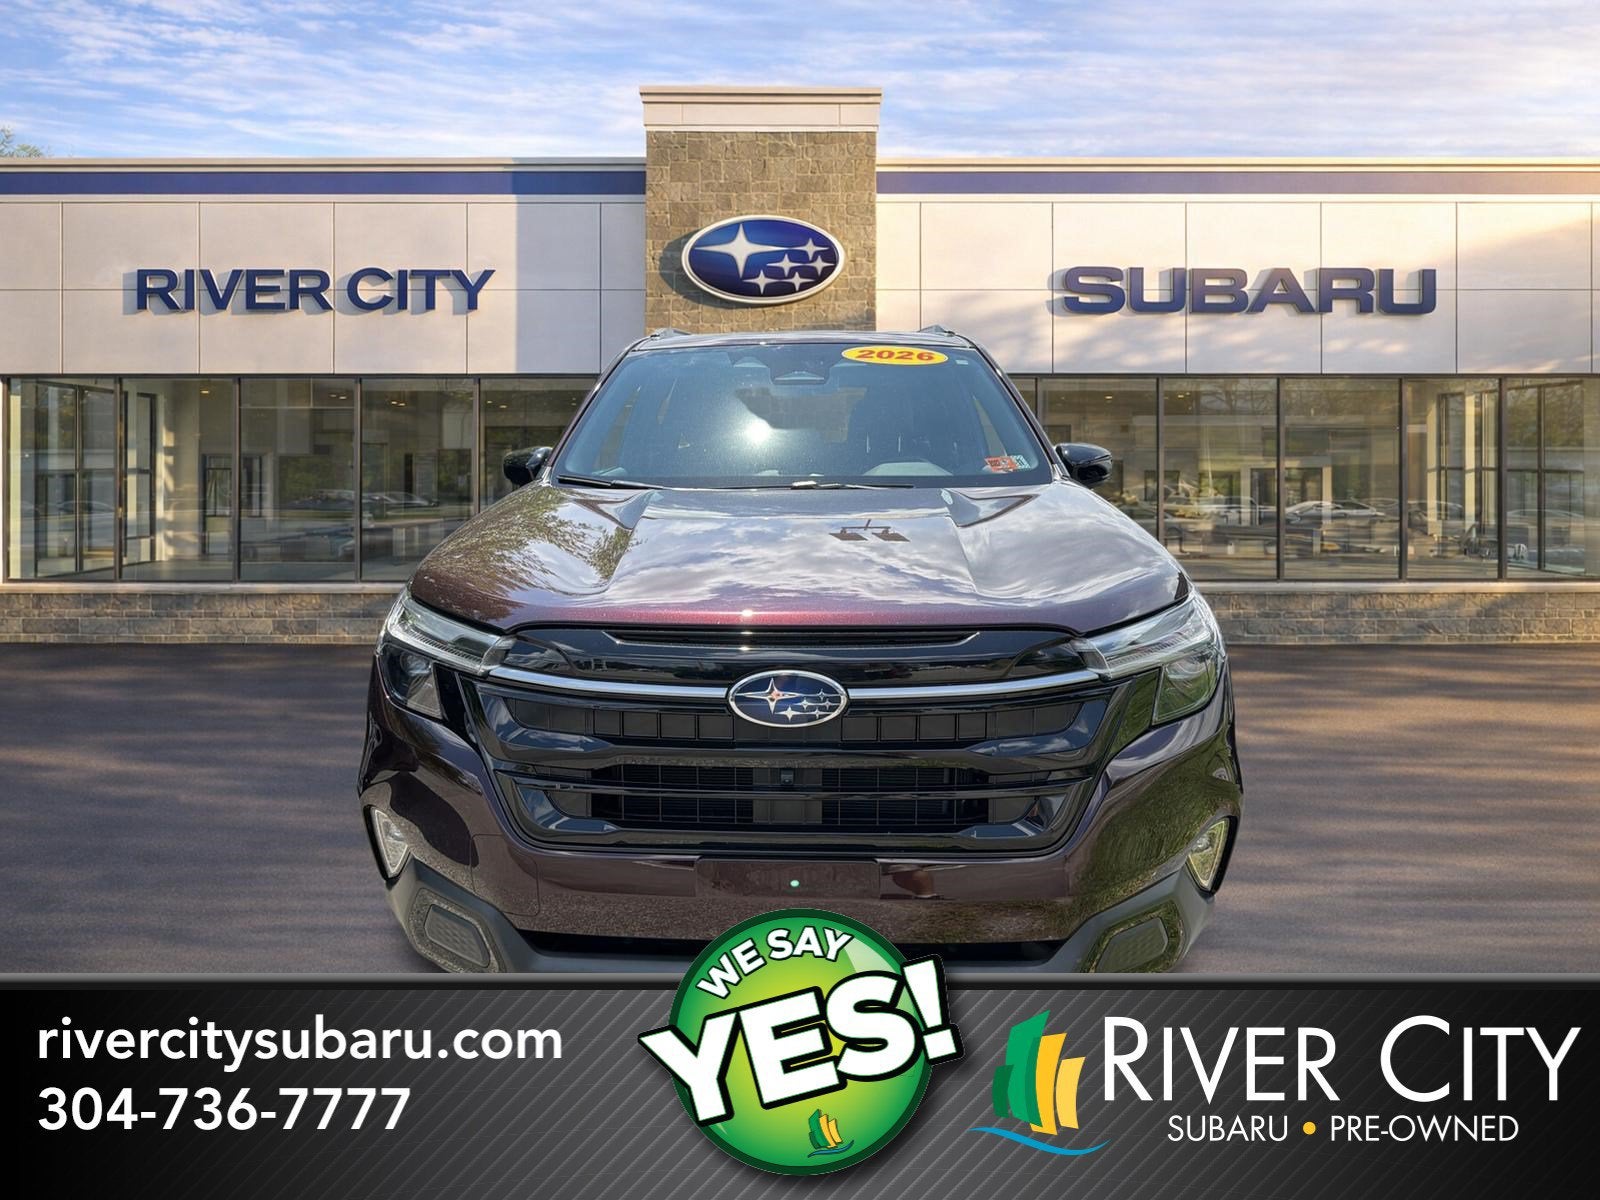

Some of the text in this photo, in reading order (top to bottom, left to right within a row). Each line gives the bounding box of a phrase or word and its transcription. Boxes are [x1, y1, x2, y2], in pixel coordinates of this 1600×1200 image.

[136, 267, 496, 311] RIVER CITY
[1063, 265, 1437, 315] SUBARU
[855, 349, 936, 362] 2026
